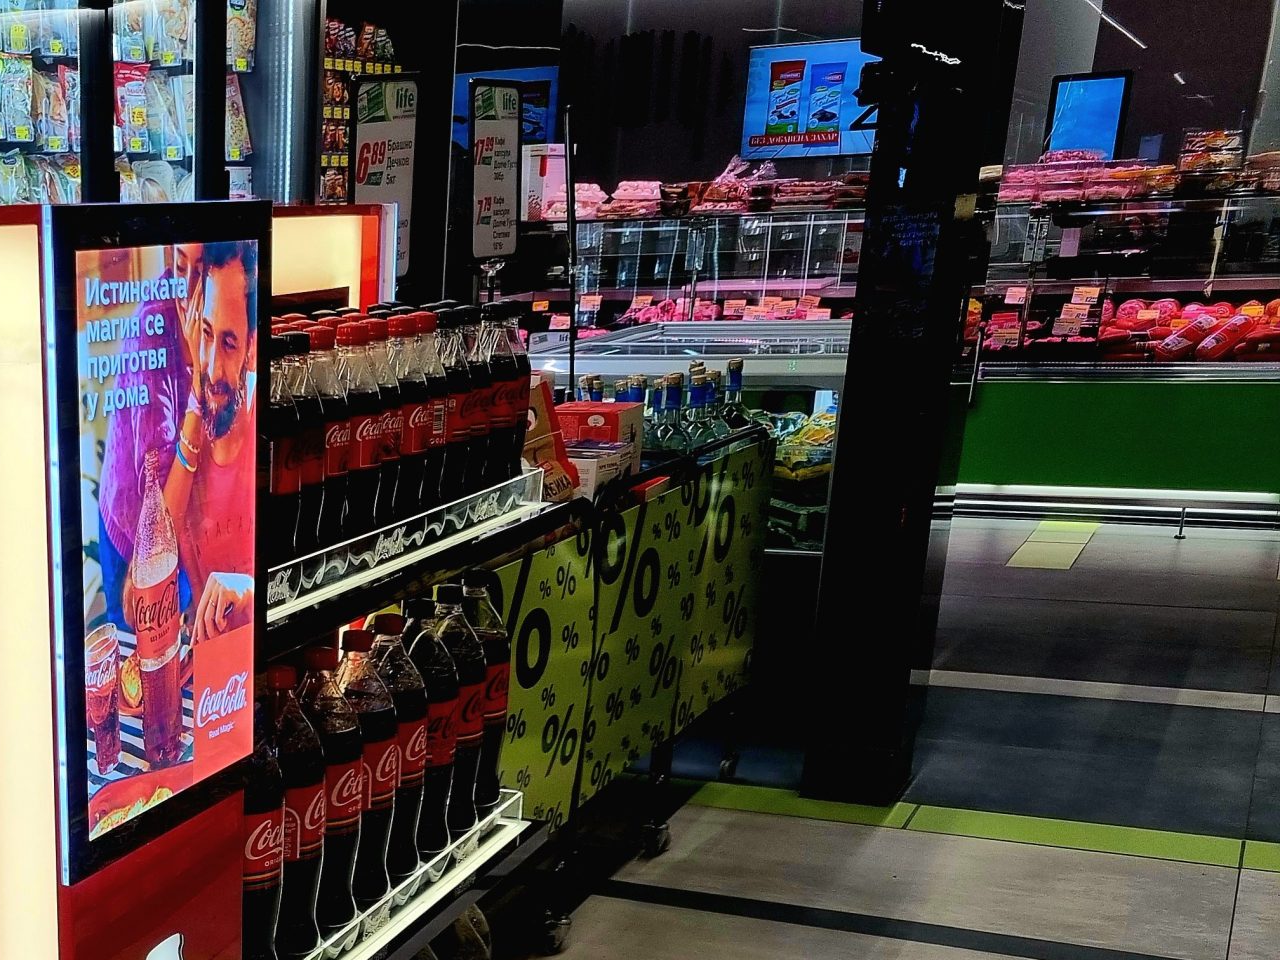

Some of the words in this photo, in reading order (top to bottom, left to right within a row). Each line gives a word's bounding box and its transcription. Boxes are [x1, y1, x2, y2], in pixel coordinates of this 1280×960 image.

[396, 88, 414, 109] life
[503, 93, 516, 110] life
[387, 140, 413, 155] Брашно
[751, 136, 766, 145] БЕЗ
[767, 134, 810, 145] ДОБАВЕНА
[811, 133, 837, 142] ЗАХАР
[85, 276, 188, 307] Истинската
[86, 317, 140, 343] магия
[145, 312, 165, 336] се
[559, 334, 570, 342] lif
[87, 347, 167, 384] приготвя
[86, 392, 99, 421] у
[103, 383, 150, 415] дома
[197, 671, 248, 728] Coca-Cola
[208, 728, 219, 739] Real
[220, 721, 234, 733] Magic
